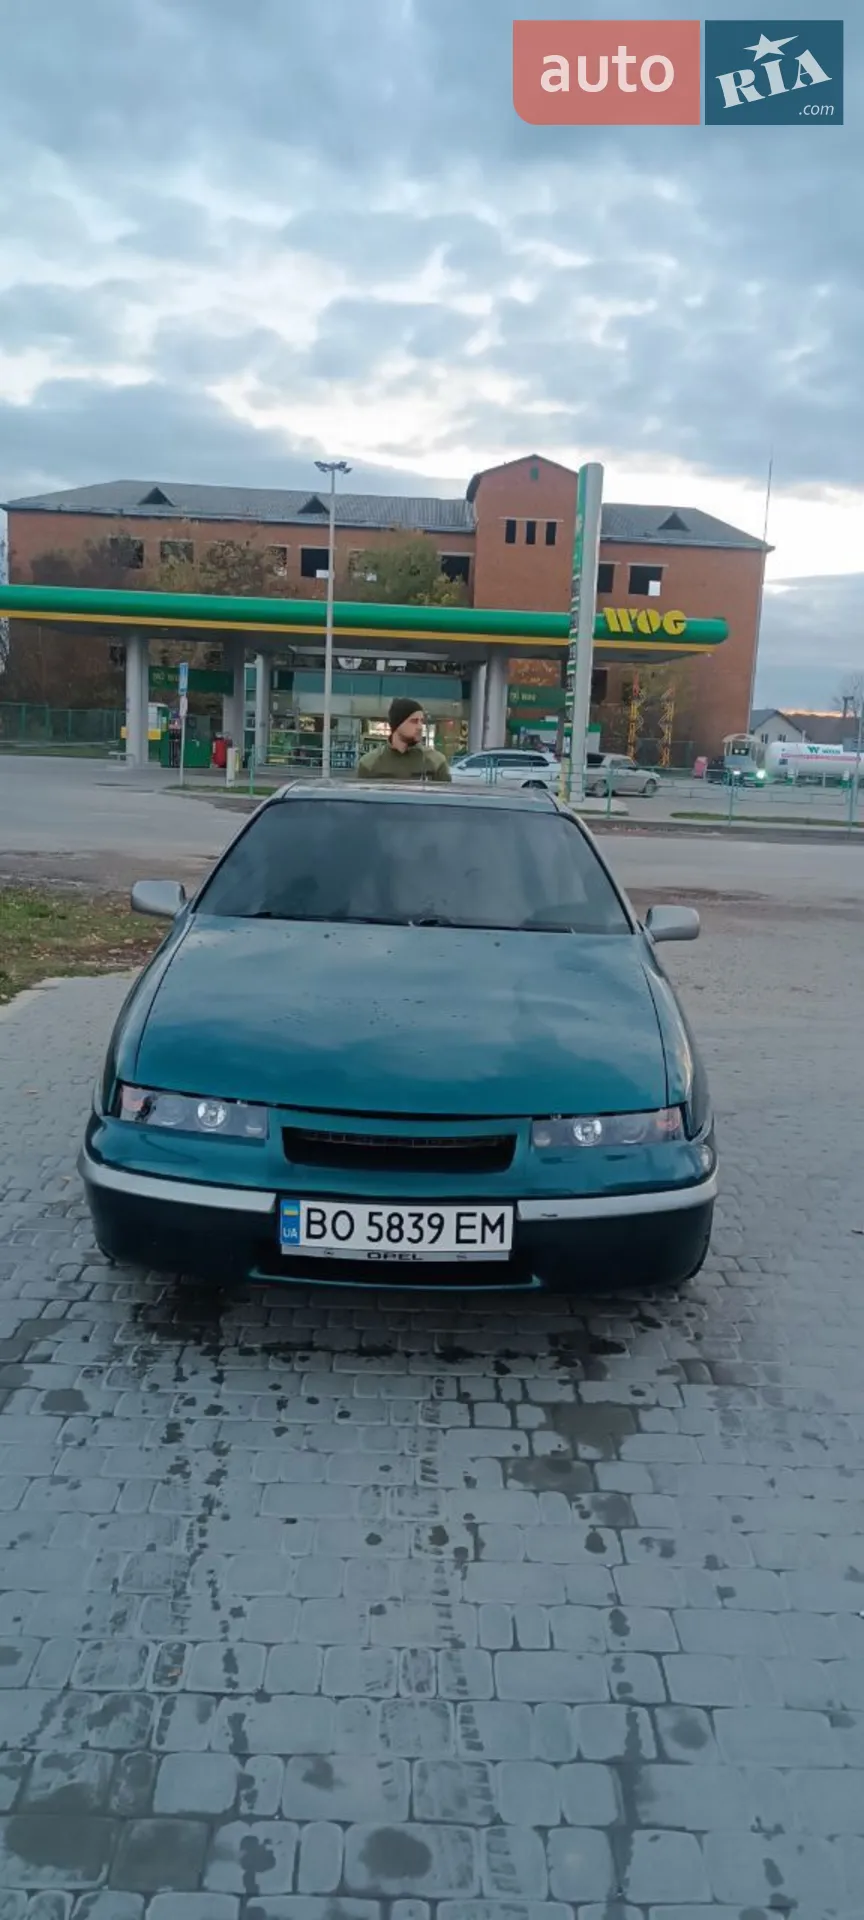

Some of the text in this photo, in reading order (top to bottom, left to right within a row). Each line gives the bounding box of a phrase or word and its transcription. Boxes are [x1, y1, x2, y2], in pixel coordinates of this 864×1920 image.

[603, 607, 686, 635] WOG
[283, 1208, 505, 1244] UA BO 5839 EM
[367, 1252, 423, 1261] OPEL
